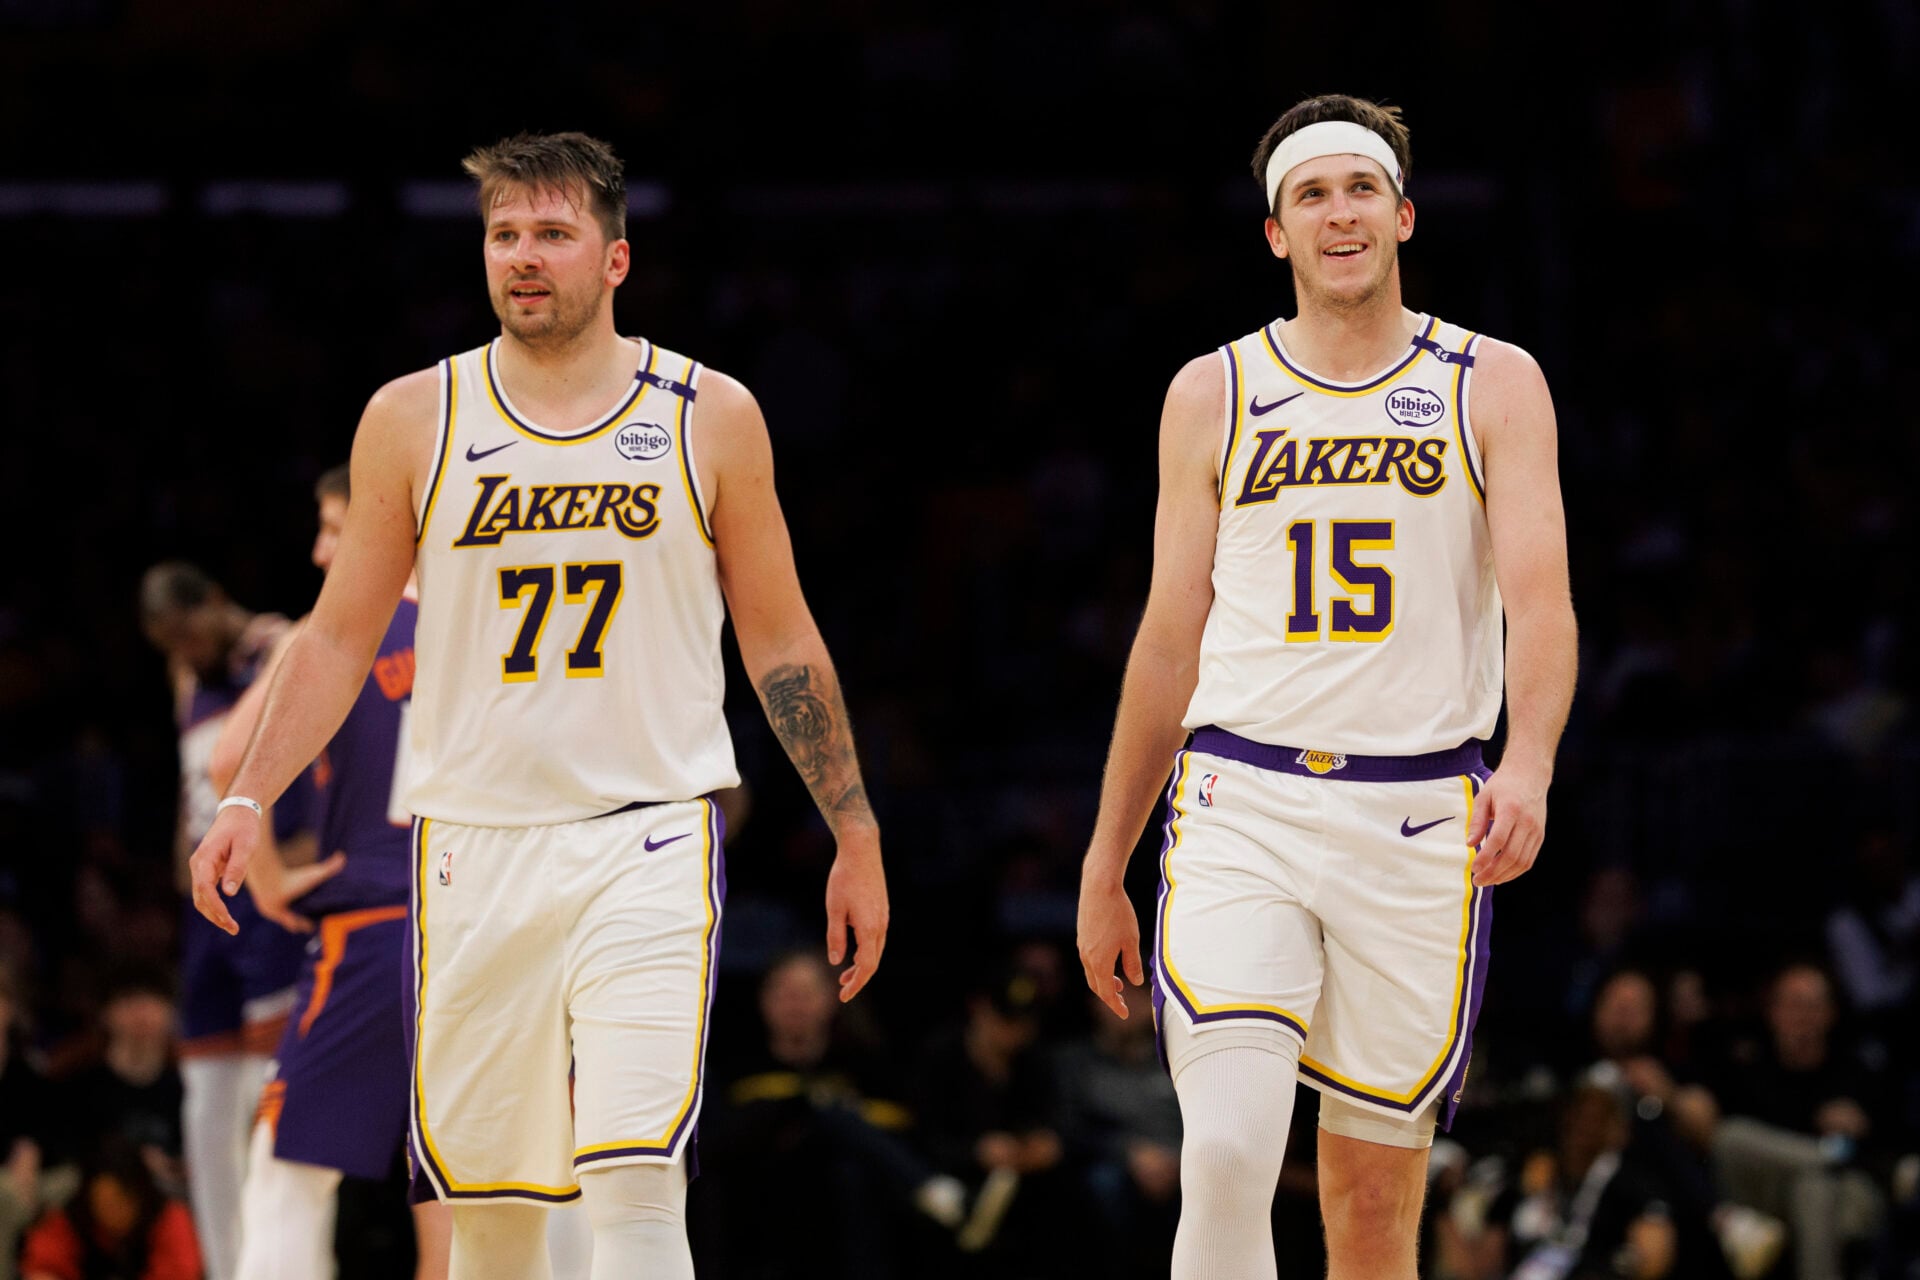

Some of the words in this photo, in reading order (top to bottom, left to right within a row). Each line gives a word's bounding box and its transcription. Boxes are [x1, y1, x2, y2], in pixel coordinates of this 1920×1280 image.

[1391, 396, 1441, 417] bibigo
[1399, 409, 1421, 418] 비비고
[620, 432, 668, 450] bibigo
[1235, 427, 1449, 509] LAKERS
[451, 473, 663, 550] LAKERS
[1284, 518, 1396, 643] 15
[496, 560, 624, 684] 77
[1297, 749, 1347, 769] LAKERS
